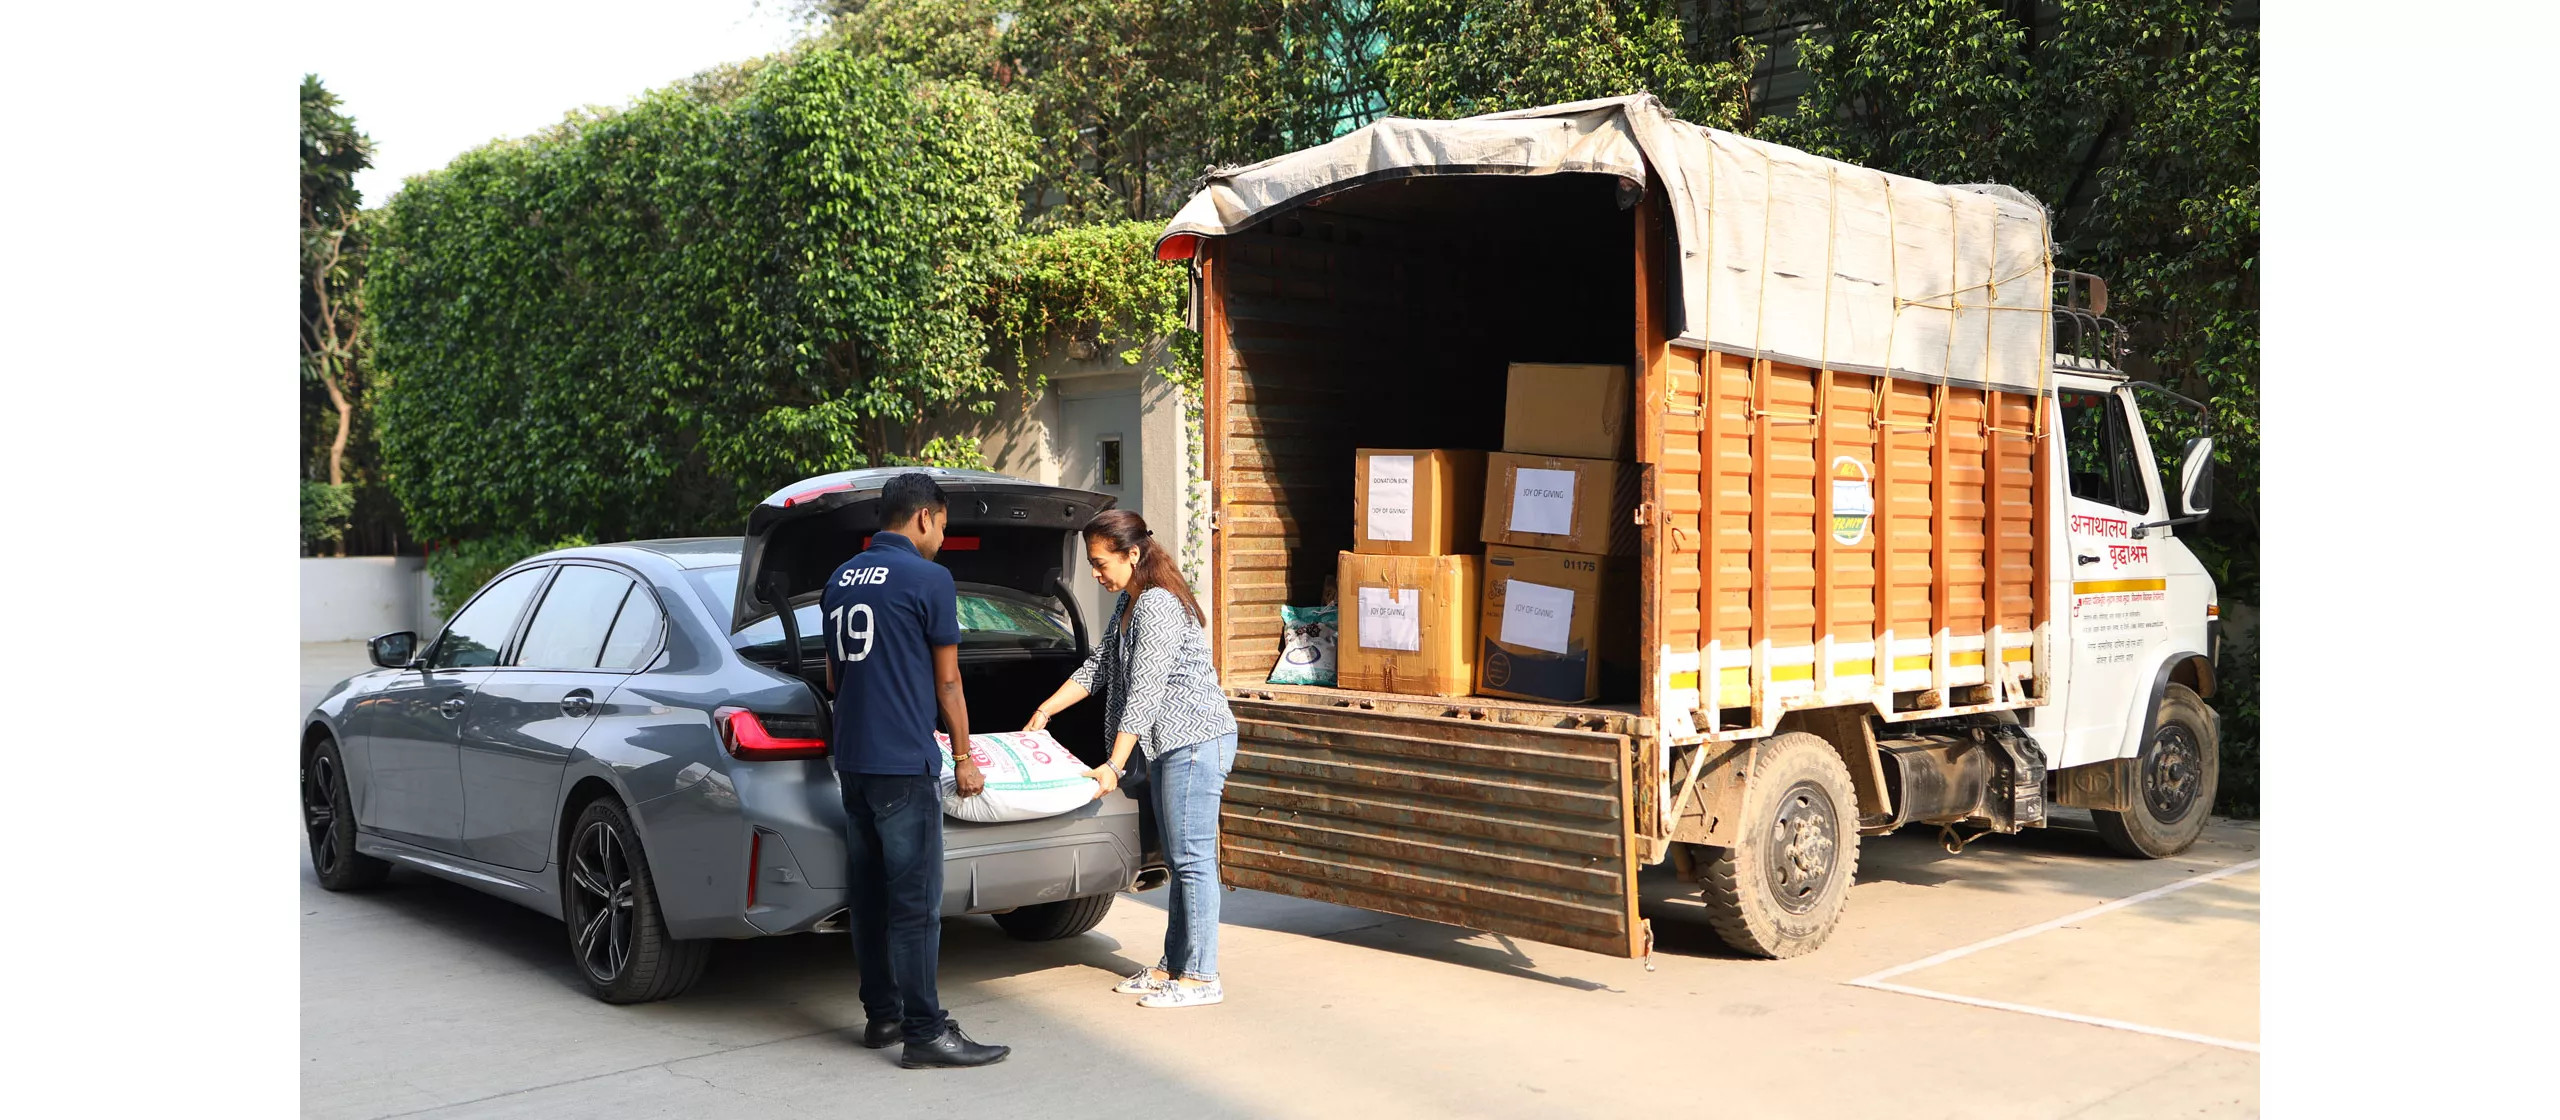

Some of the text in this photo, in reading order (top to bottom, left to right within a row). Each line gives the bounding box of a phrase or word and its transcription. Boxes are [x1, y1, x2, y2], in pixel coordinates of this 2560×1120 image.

[1523, 488, 1564, 499] JOY OF GIVING
[2071, 515, 2127, 539] अनाथालय
[1563, 559, 1596, 572] 01175
[2108, 545, 2148, 570] वृद्धाश्रम
[838, 567, 889, 587] SHIB
[1370, 607, 1405, 617] JOY OF GIVING
[1514, 603, 1525, 612] JOY
[1525, 605, 1534, 614] OF
[1534, 607, 1554, 618] GIVING
[830, 603, 875, 662] 19
